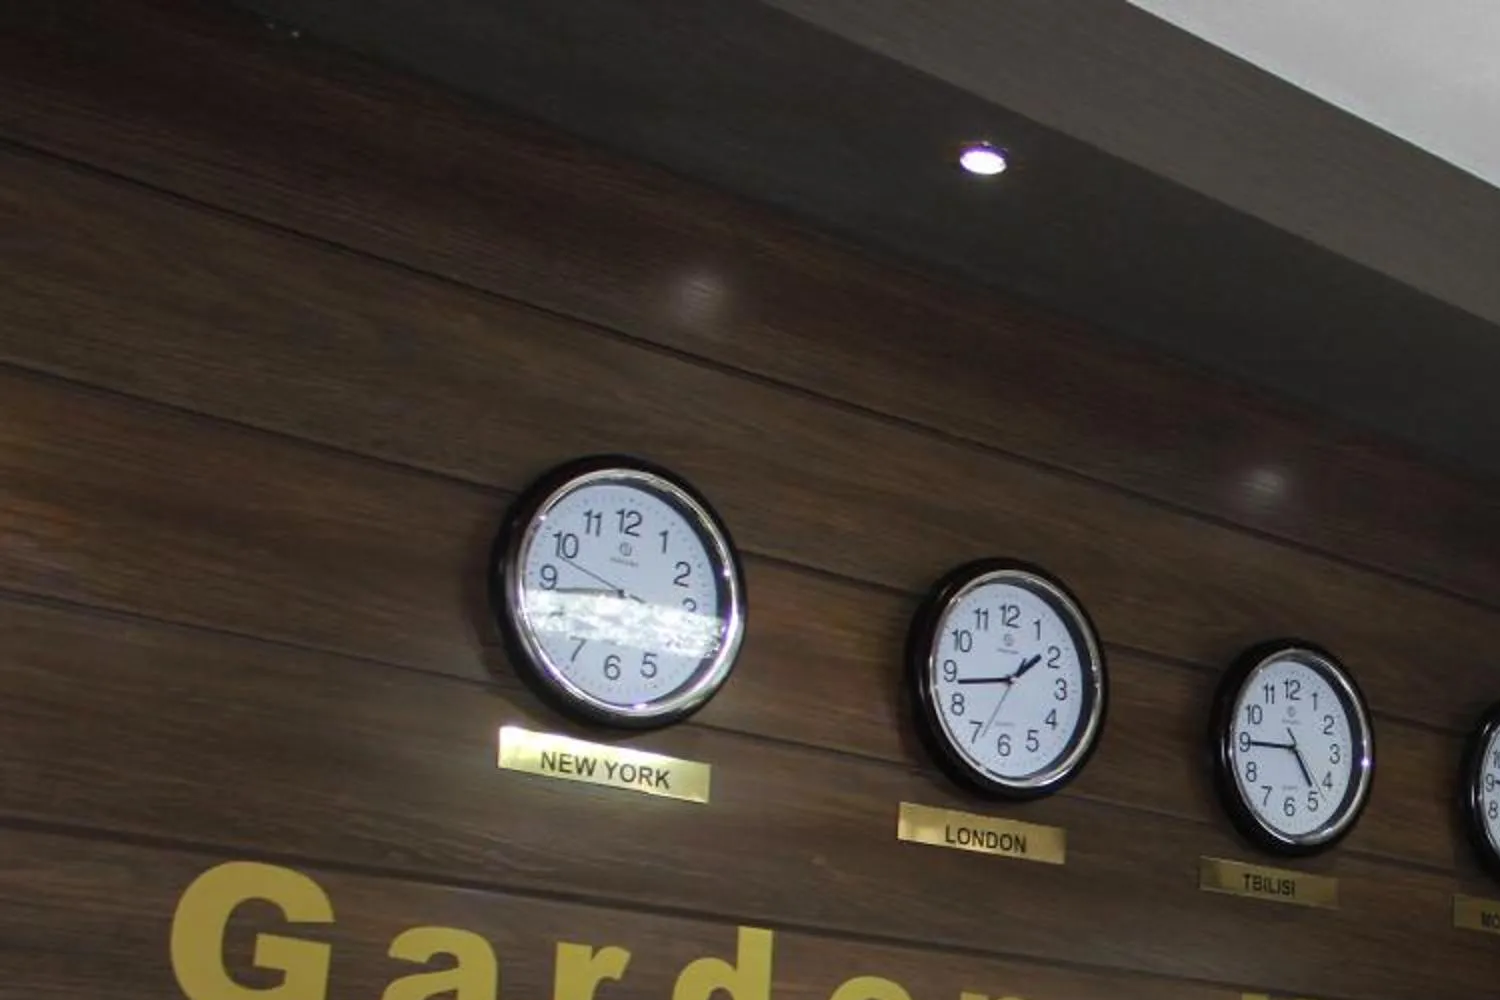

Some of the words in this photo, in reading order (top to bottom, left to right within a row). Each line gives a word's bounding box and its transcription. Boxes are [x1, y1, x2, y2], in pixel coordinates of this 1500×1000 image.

[584, 509, 602, 536] 11
[616, 508, 643, 537] 12
[554, 532, 579, 558] 10
[658, 530, 669, 554] 1
[540, 564, 557, 590] 9
[673, 561, 691, 588] 2
[974, 608, 990, 631] 11
[1000, 604, 1020, 629] 12
[952, 629, 973, 653] 10
[1033, 620, 1042, 641] 1
[569, 635, 587, 663] 7
[1047, 646, 1061, 669] 2
[603, 655, 621, 681] 6
[640, 653, 658, 679] 5
[943, 659, 958, 683] 9
[1053, 679, 1067, 701] 3
[1263, 682, 1275, 704] 11
[1284, 679, 1301, 701] 12
[1311, 692, 1318, 711] 1
[950, 693, 965, 716] 8
[1246, 703, 1263, 725] 10
[1045, 708, 1058, 730] 4
[1323, 715, 1335, 735] 2
[969, 721, 983, 744] 7
[1025, 729, 1040, 752] 5
[1239, 731, 1251, 753] 9
[997, 734, 1012, 757] 6
[1329, 744, 1341, 764] 3
[541, 751, 597, 777] NEW
[604, 759, 671, 790] YORK
[1245, 761, 1257, 782] 8
[1322, 771, 1333, 790] 4
[1485, 773, 1496, 792] 9
[1260, 785, 1272, 806] 7
[1283, 796, 1296, 817] 6
[1307, 791, 1319, 812] 5
[1488, 800, 1499, 819] 8
[945, 823, 1027, 854] LONDON
[1243, 872, 1296, 899] TBILISI
